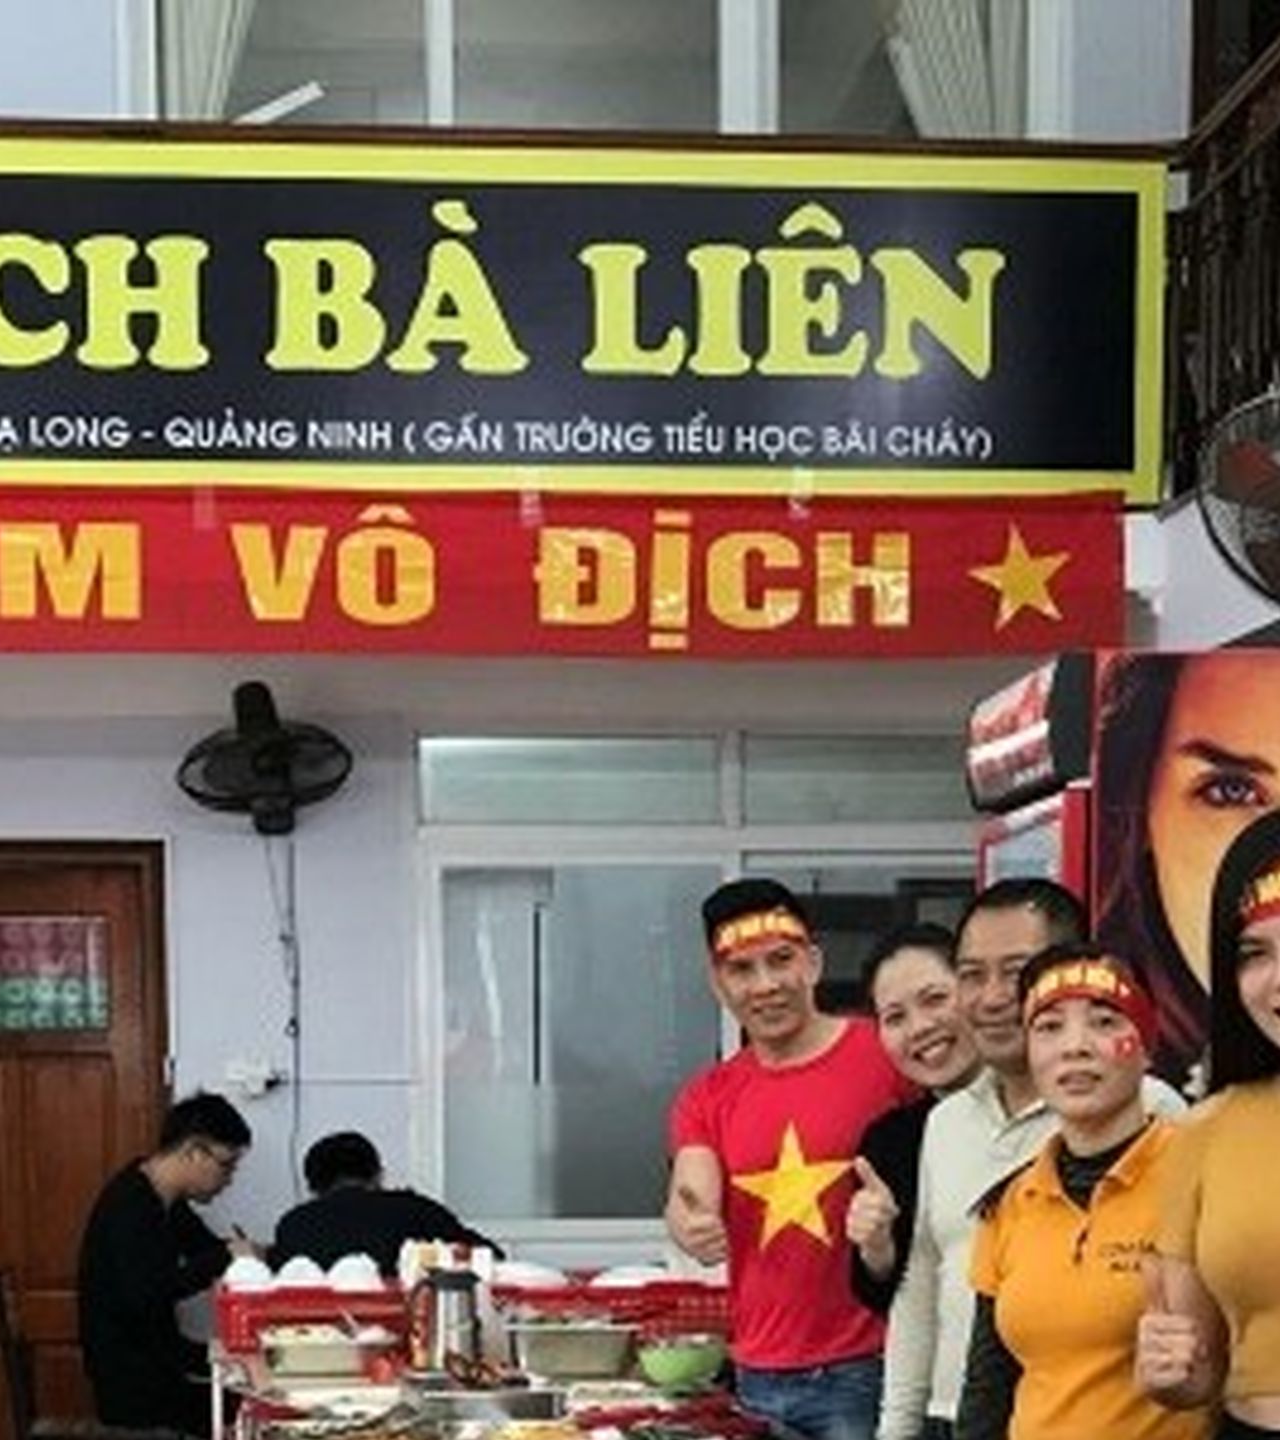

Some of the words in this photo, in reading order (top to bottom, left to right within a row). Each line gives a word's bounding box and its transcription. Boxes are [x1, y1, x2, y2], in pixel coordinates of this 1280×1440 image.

[264, 200, 529, 375] BÀ
[579, 203, 1006, 380] LIÊN
[29, 416, 131, 448] LONG
[164, 408, 298, 449] QUẢNG
[307, 421, 392, 449] NINH
[735, 425, 814, 461] HỌC
[230, 504, 436, 625] VÔ
